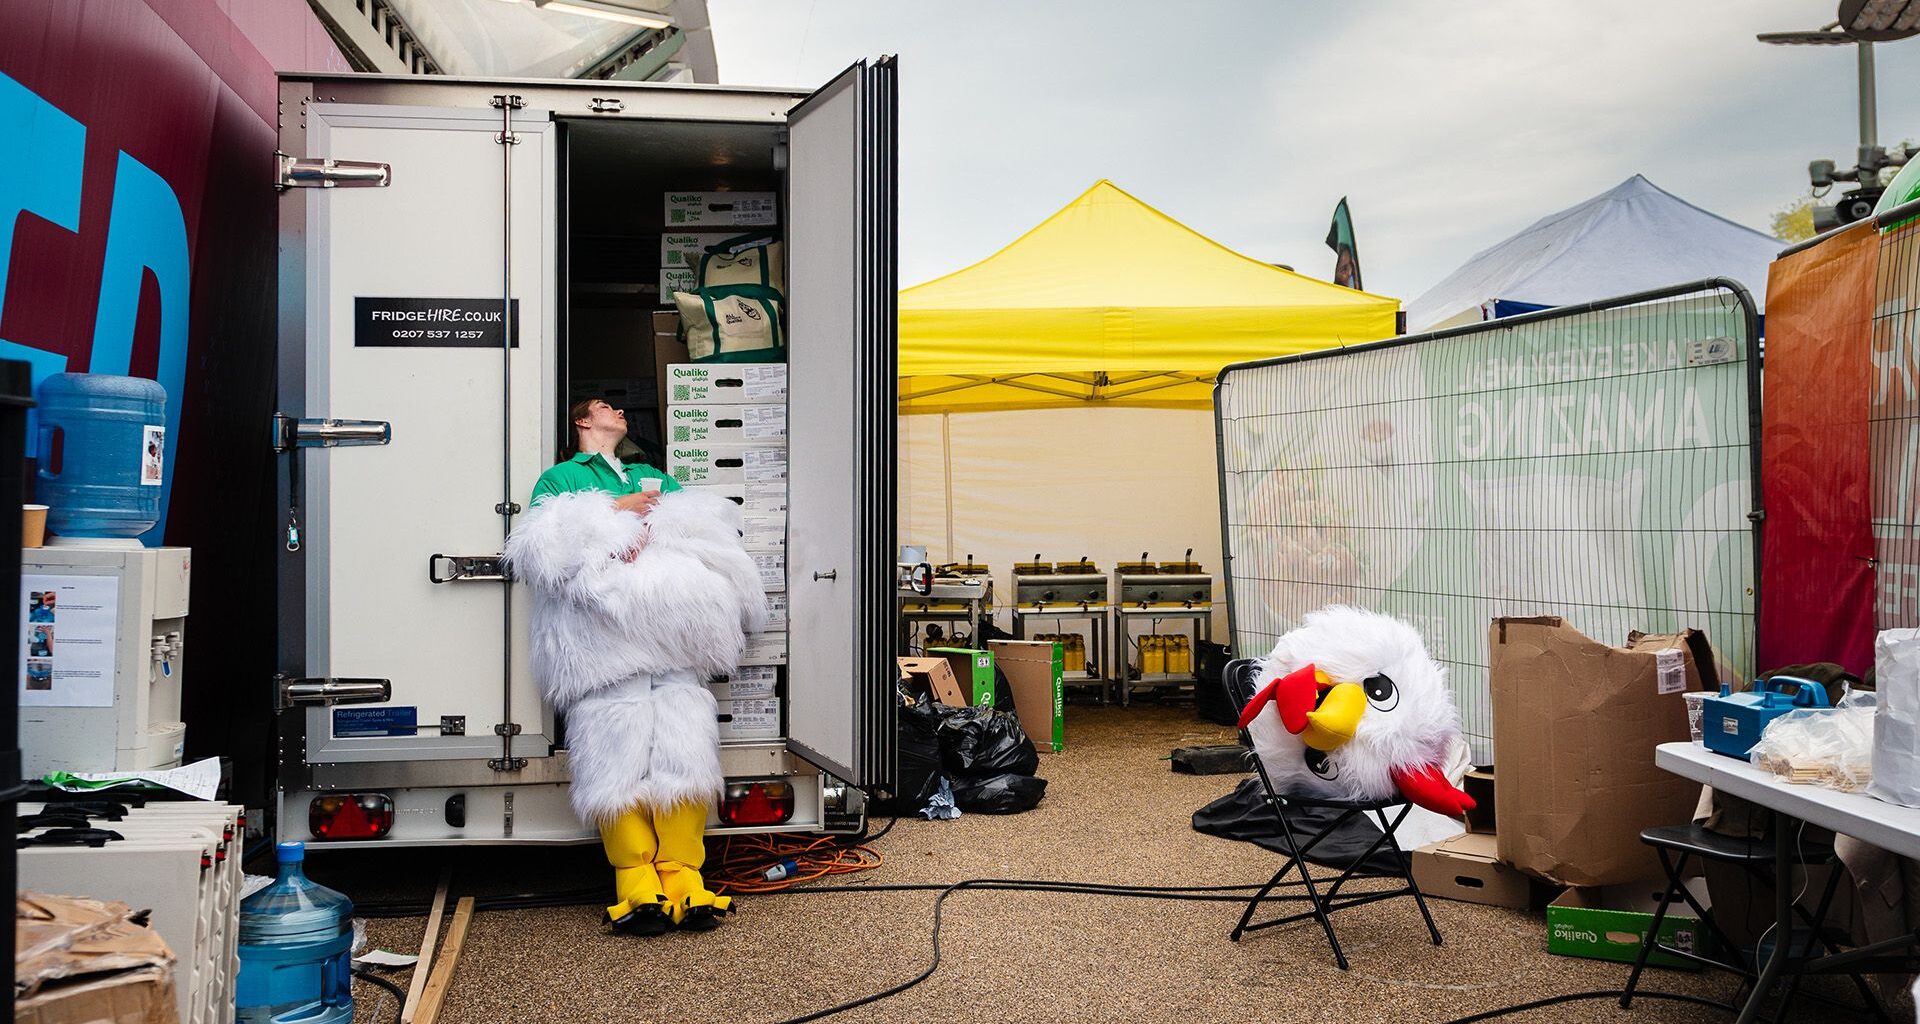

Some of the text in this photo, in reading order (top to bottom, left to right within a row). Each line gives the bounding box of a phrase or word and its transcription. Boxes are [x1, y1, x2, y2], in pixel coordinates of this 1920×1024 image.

[670, 195, 702, 203] Qualiko
[667, 236, 698, 245] Qualiko
[372, 308, 501, 323] FRIDGEHIRE.CO.UK
[392, 330, 484, 339] 0207 537 1257
[673, 368, 708, 378] Qualiko
[673, 410, 708, 419] Qualiko
[673, 450, 708, 459] Qualiko
[337, 711, 386, 720] Refrigerated
[1554, 930, 1598, 943] Qualiko
